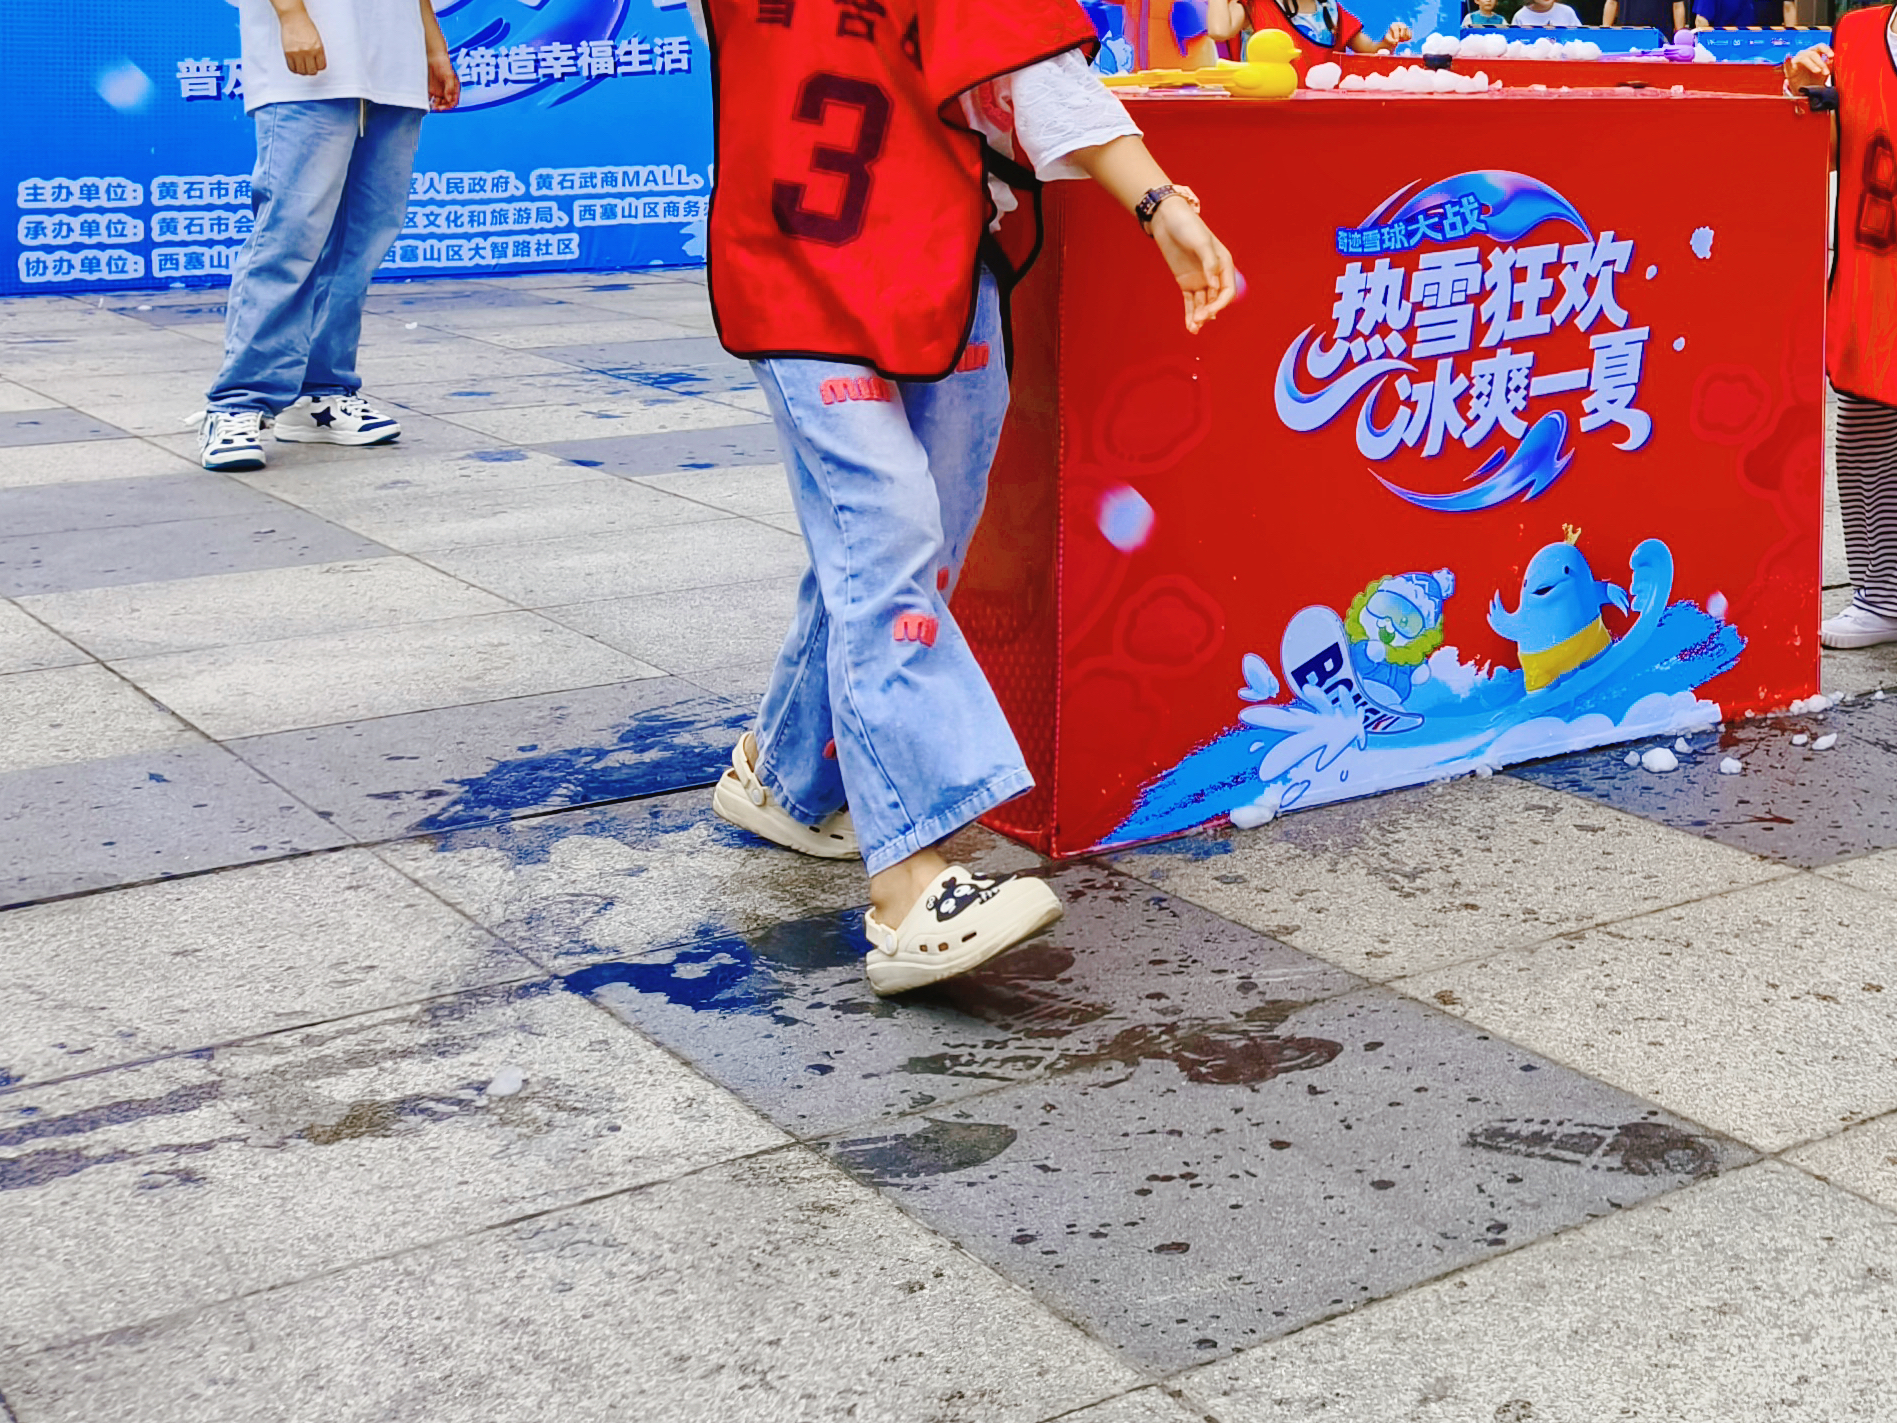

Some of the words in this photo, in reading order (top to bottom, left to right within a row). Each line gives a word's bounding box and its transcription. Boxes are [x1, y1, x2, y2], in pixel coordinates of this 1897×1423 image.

[456, 36, 690, 86] 缔造幸福生活
[771, 68, 895, 250] 3
[1336, 194, 1487, 254] 奇迹雪球大战
[1308, 230, 1633, 378] 热雪狂欢
[1358, 326, 1653, 460] 冰爽一夏
